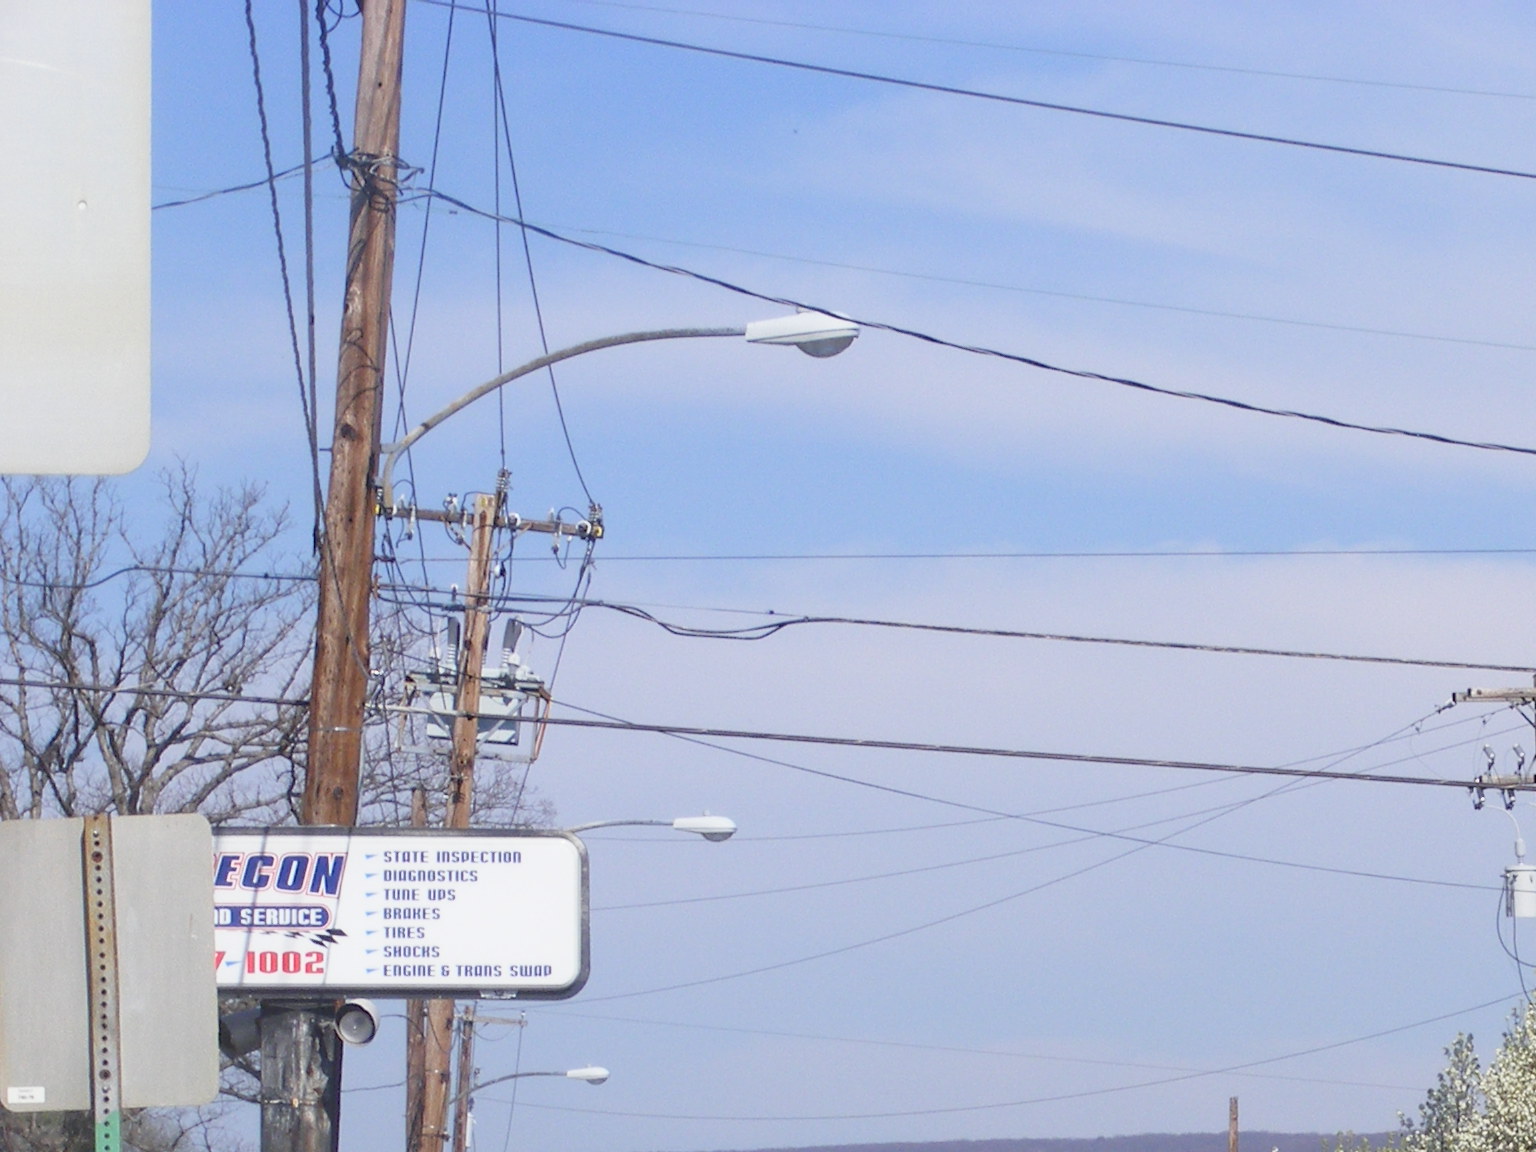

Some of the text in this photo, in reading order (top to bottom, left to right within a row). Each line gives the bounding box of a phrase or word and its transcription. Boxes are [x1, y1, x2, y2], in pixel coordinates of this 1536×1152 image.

[383, 850, 522, 864] STATE INSPECTION
[213, 852, 348, 898] ECON
[383, 869, 479, 883] DIAGNOSTICS
[383, 888, 457, 901] TUNE UPS
[214, 907, 323, 926] D SERVICE
[383, 907, 441, 920] BRAKES
[383, 926, 426, 939] TIRES
[383, 945, 441, 958] SHOCKS
[383, 964, 553, 978] ENGINE & TRANS SWAP
